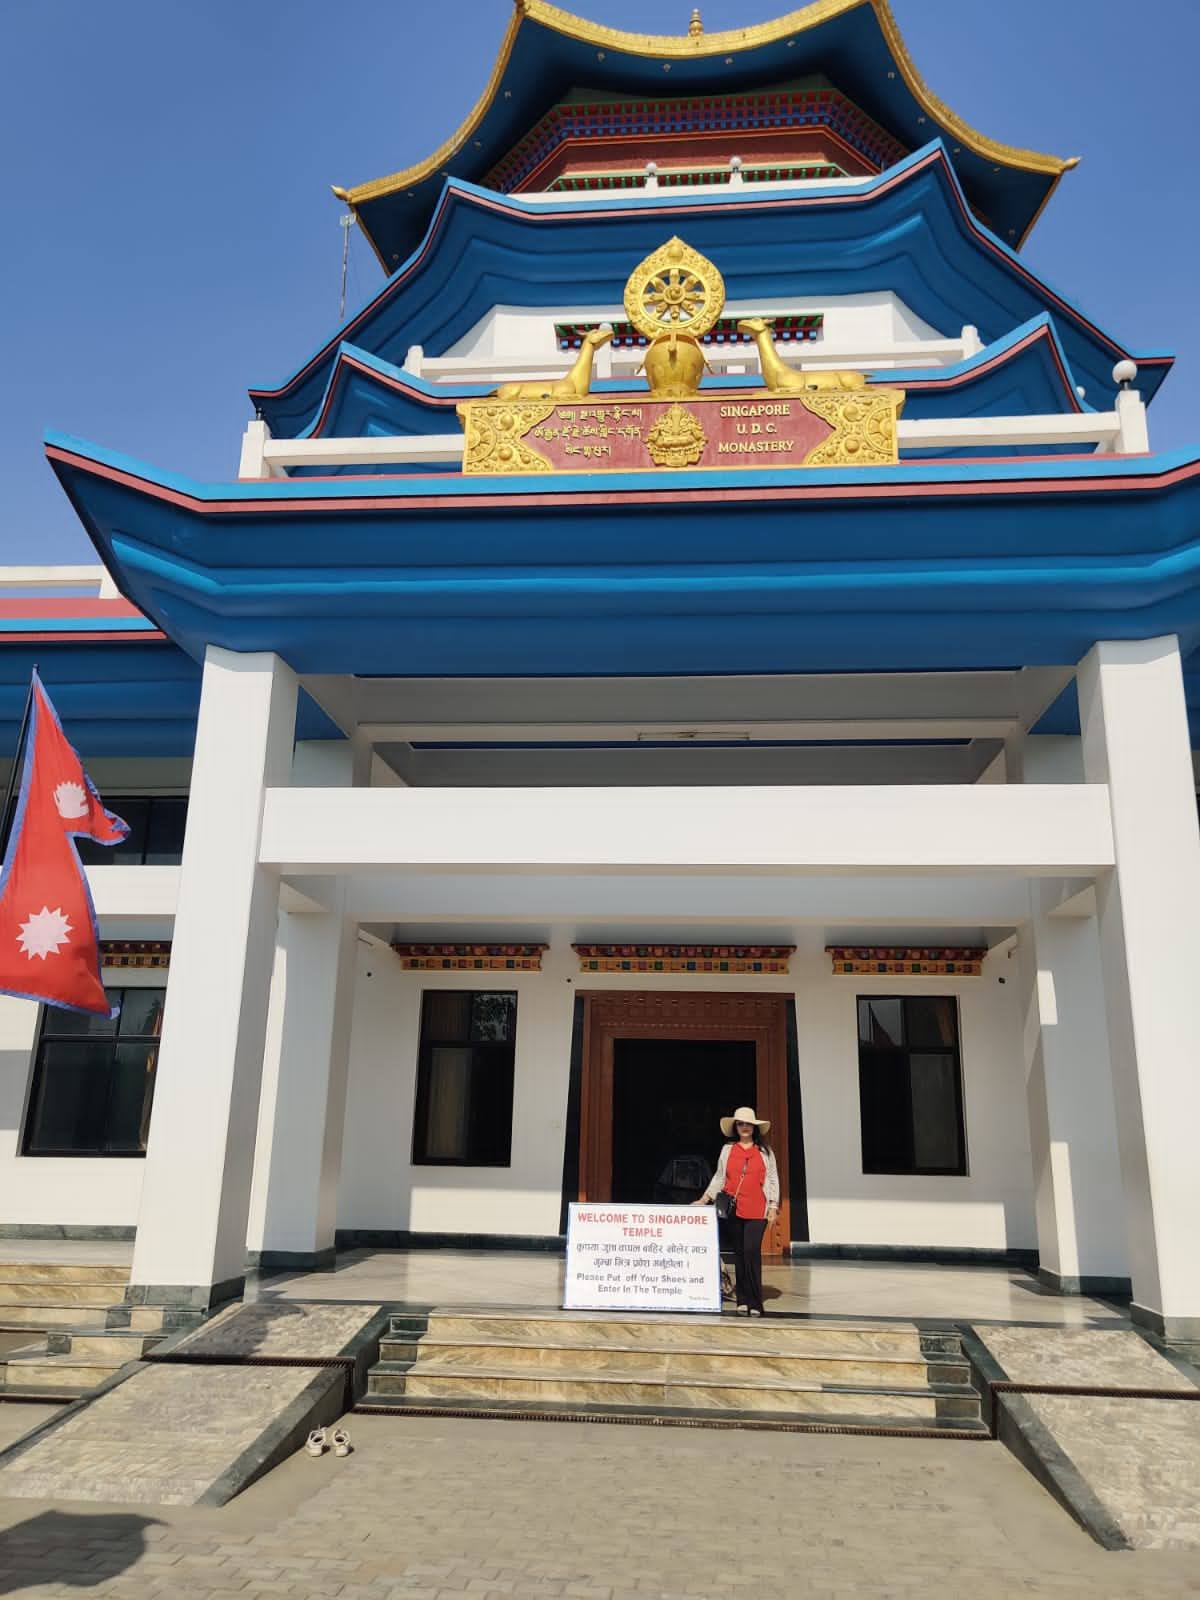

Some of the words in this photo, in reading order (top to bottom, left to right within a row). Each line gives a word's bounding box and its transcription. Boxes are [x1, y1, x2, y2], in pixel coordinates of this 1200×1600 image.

[720, 404, 791, 417] SINGAPORE
[736, 423, 748, 434] U.
[751, 423, 762, 434] D.
[766, 423, 777, 433] C.
[718, 440, 794, 453] MONASTERY
[577, 1212, 629, 1224] WELCOME
[632, 1214, 645, 1224] TO
[648, 1214, 708, 1225] SINGAPORE
[623, 1227, 663, 1238] TEMPLE
[577, 1272, 605, 1282] Please
[607, 1273, 621, 1282] Put
[625, 1273, 638, 1282] off
[640, 1274, 659, 1283] Your
[661, 1275, 687, 1284] Shoes
[689, 1275, 705, 1284] and
[598, 1284, 621, 1293] Enter
[623, 1285, 631, 1293] In
[634, 1286, 650, 1294] The
[652, 1286, 683, 1297] Temple
